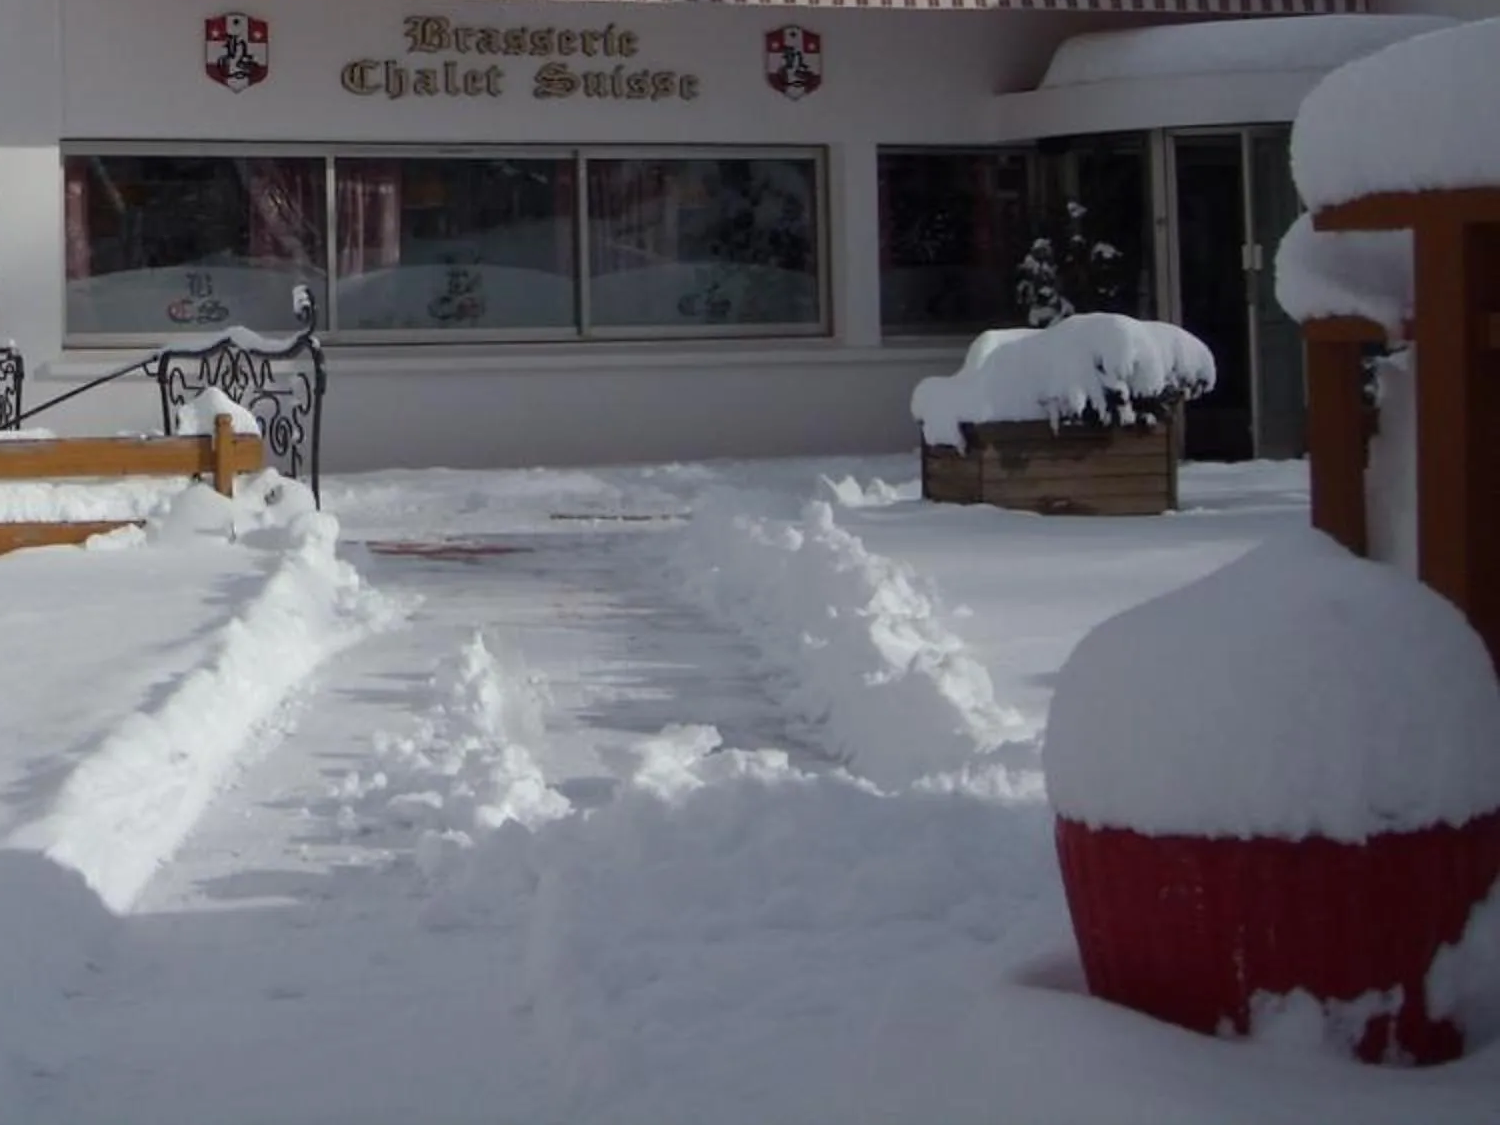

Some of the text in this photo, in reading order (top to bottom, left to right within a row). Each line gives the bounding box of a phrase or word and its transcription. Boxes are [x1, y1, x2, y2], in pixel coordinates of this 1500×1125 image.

[402, 15, 640, 59] Brasserie
[340, 57, 702, 102] Chalet Suisse
